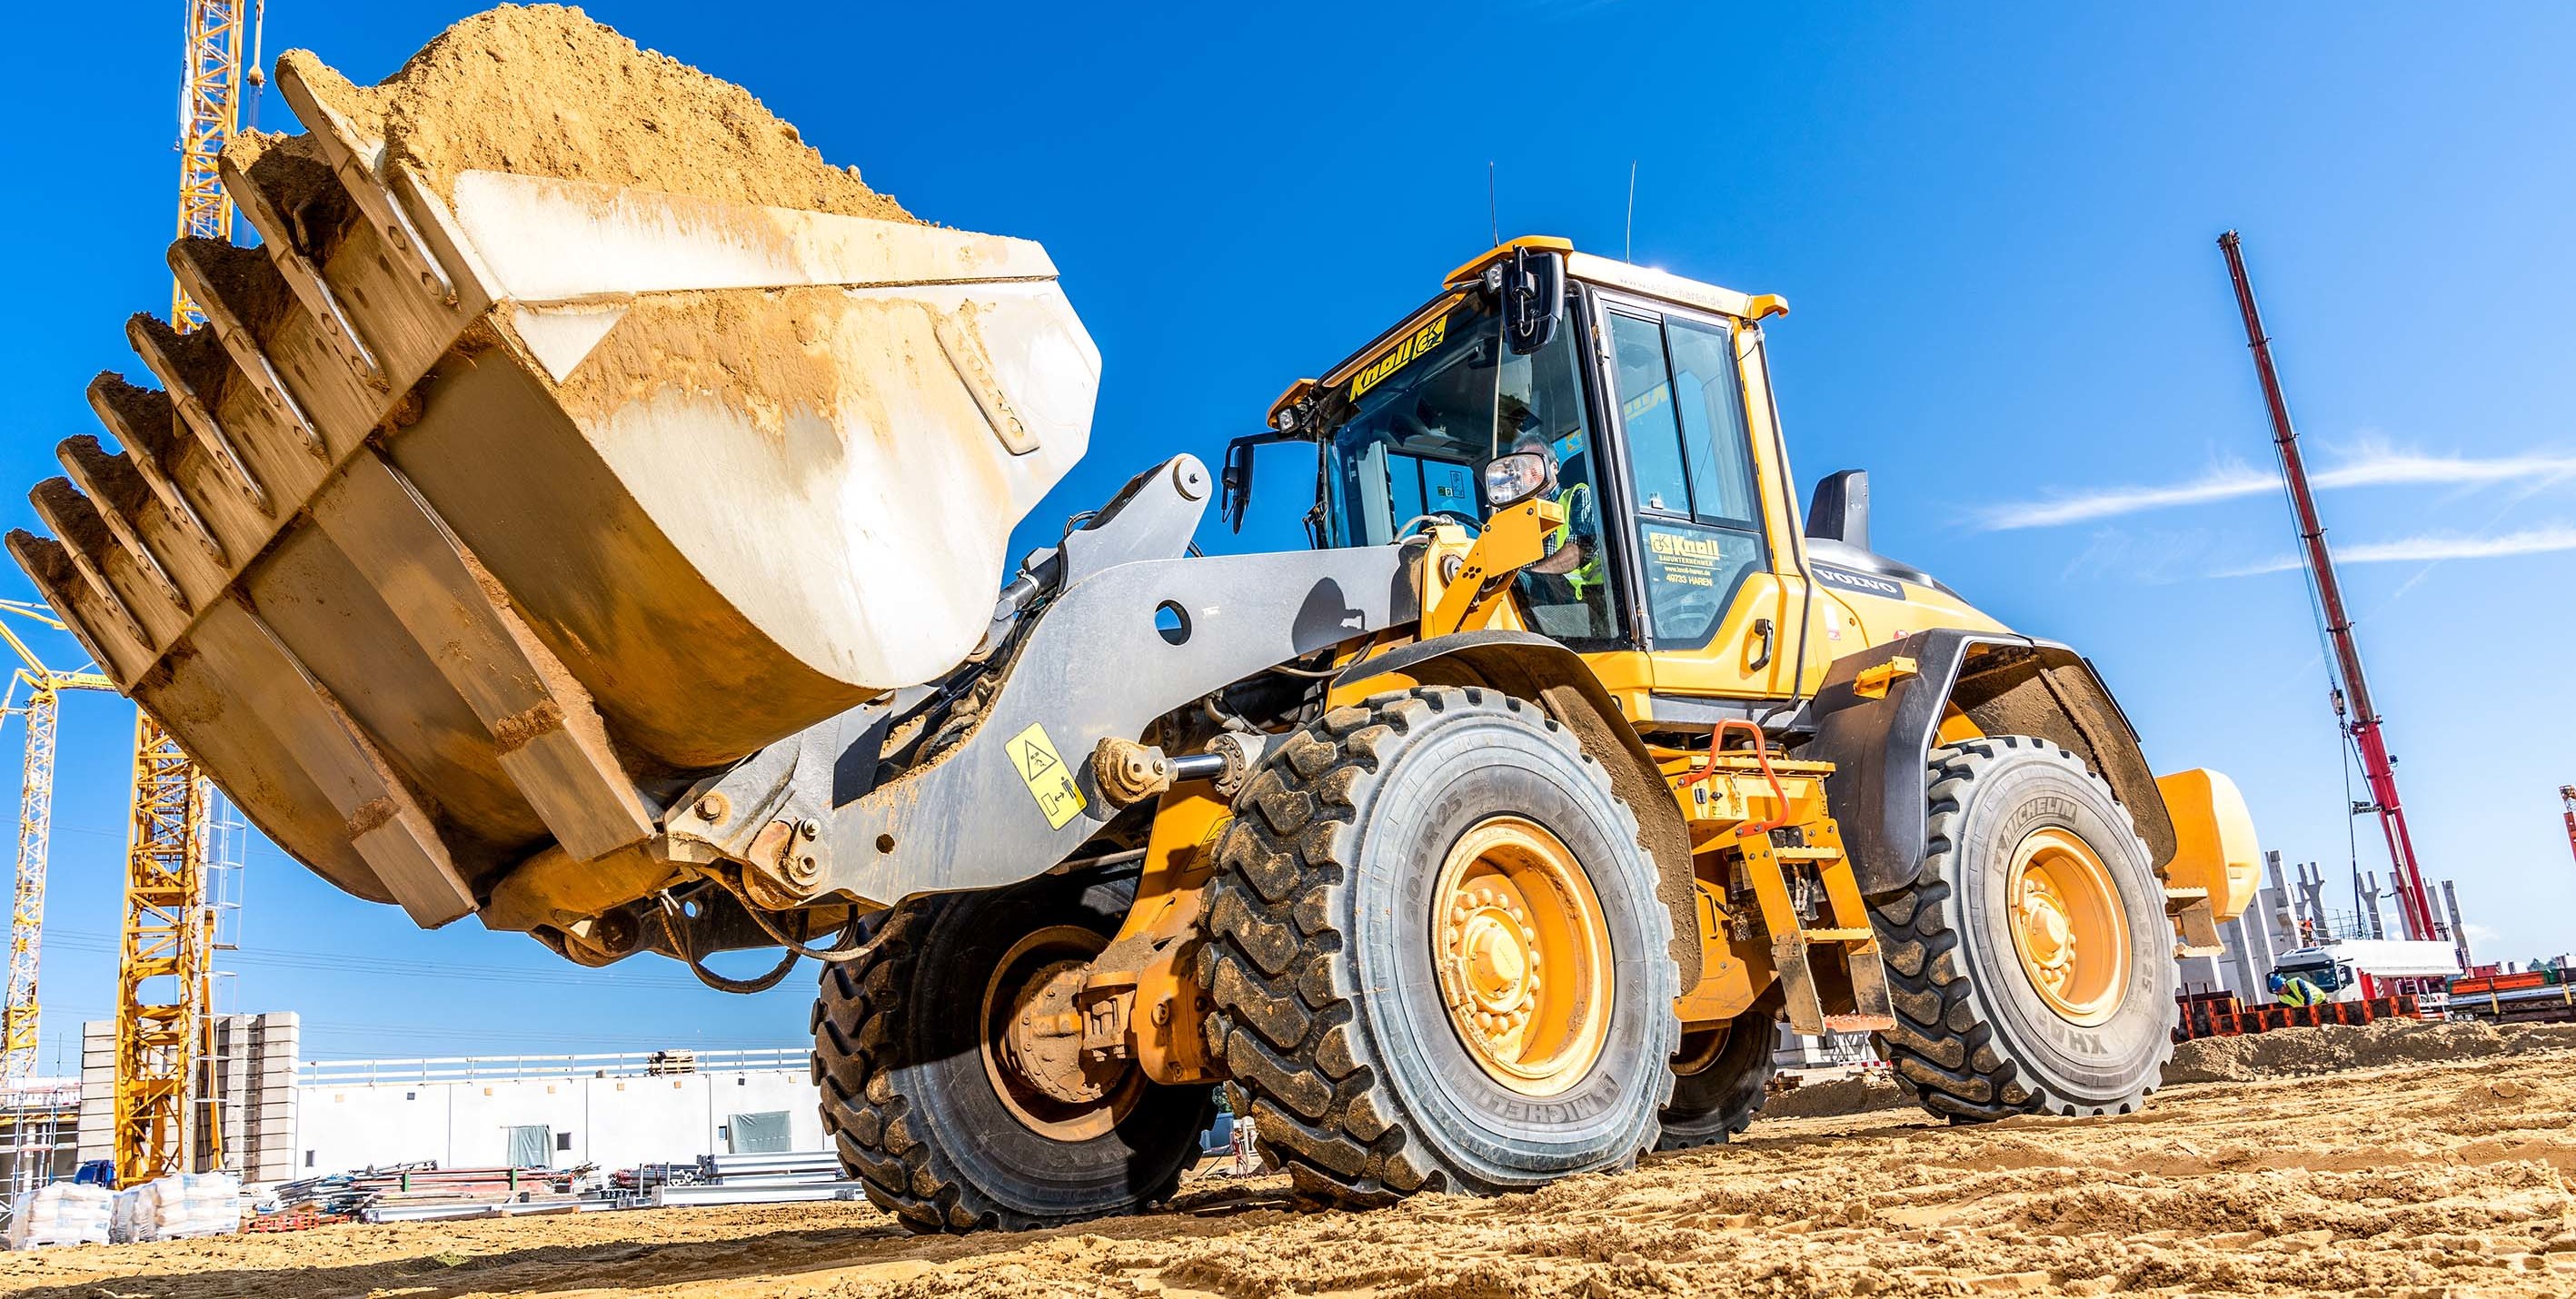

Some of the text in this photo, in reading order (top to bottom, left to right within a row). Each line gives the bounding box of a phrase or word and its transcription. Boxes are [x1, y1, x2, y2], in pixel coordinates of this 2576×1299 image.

[1349, 336, 1415, 402] Knoll
[1673, 535, 1720, 560] Knoll
[1658, 555, 1715, 567] BAUUNTERNEHMEN
[1666, 574, 1713, 587] 49733 HAREN
[1811, 568, 1898, 593] VOLVO
[2002, 797, 2077, 848] MICHELIN
[1453, 1072, 1601, 1123] MICHELIN
